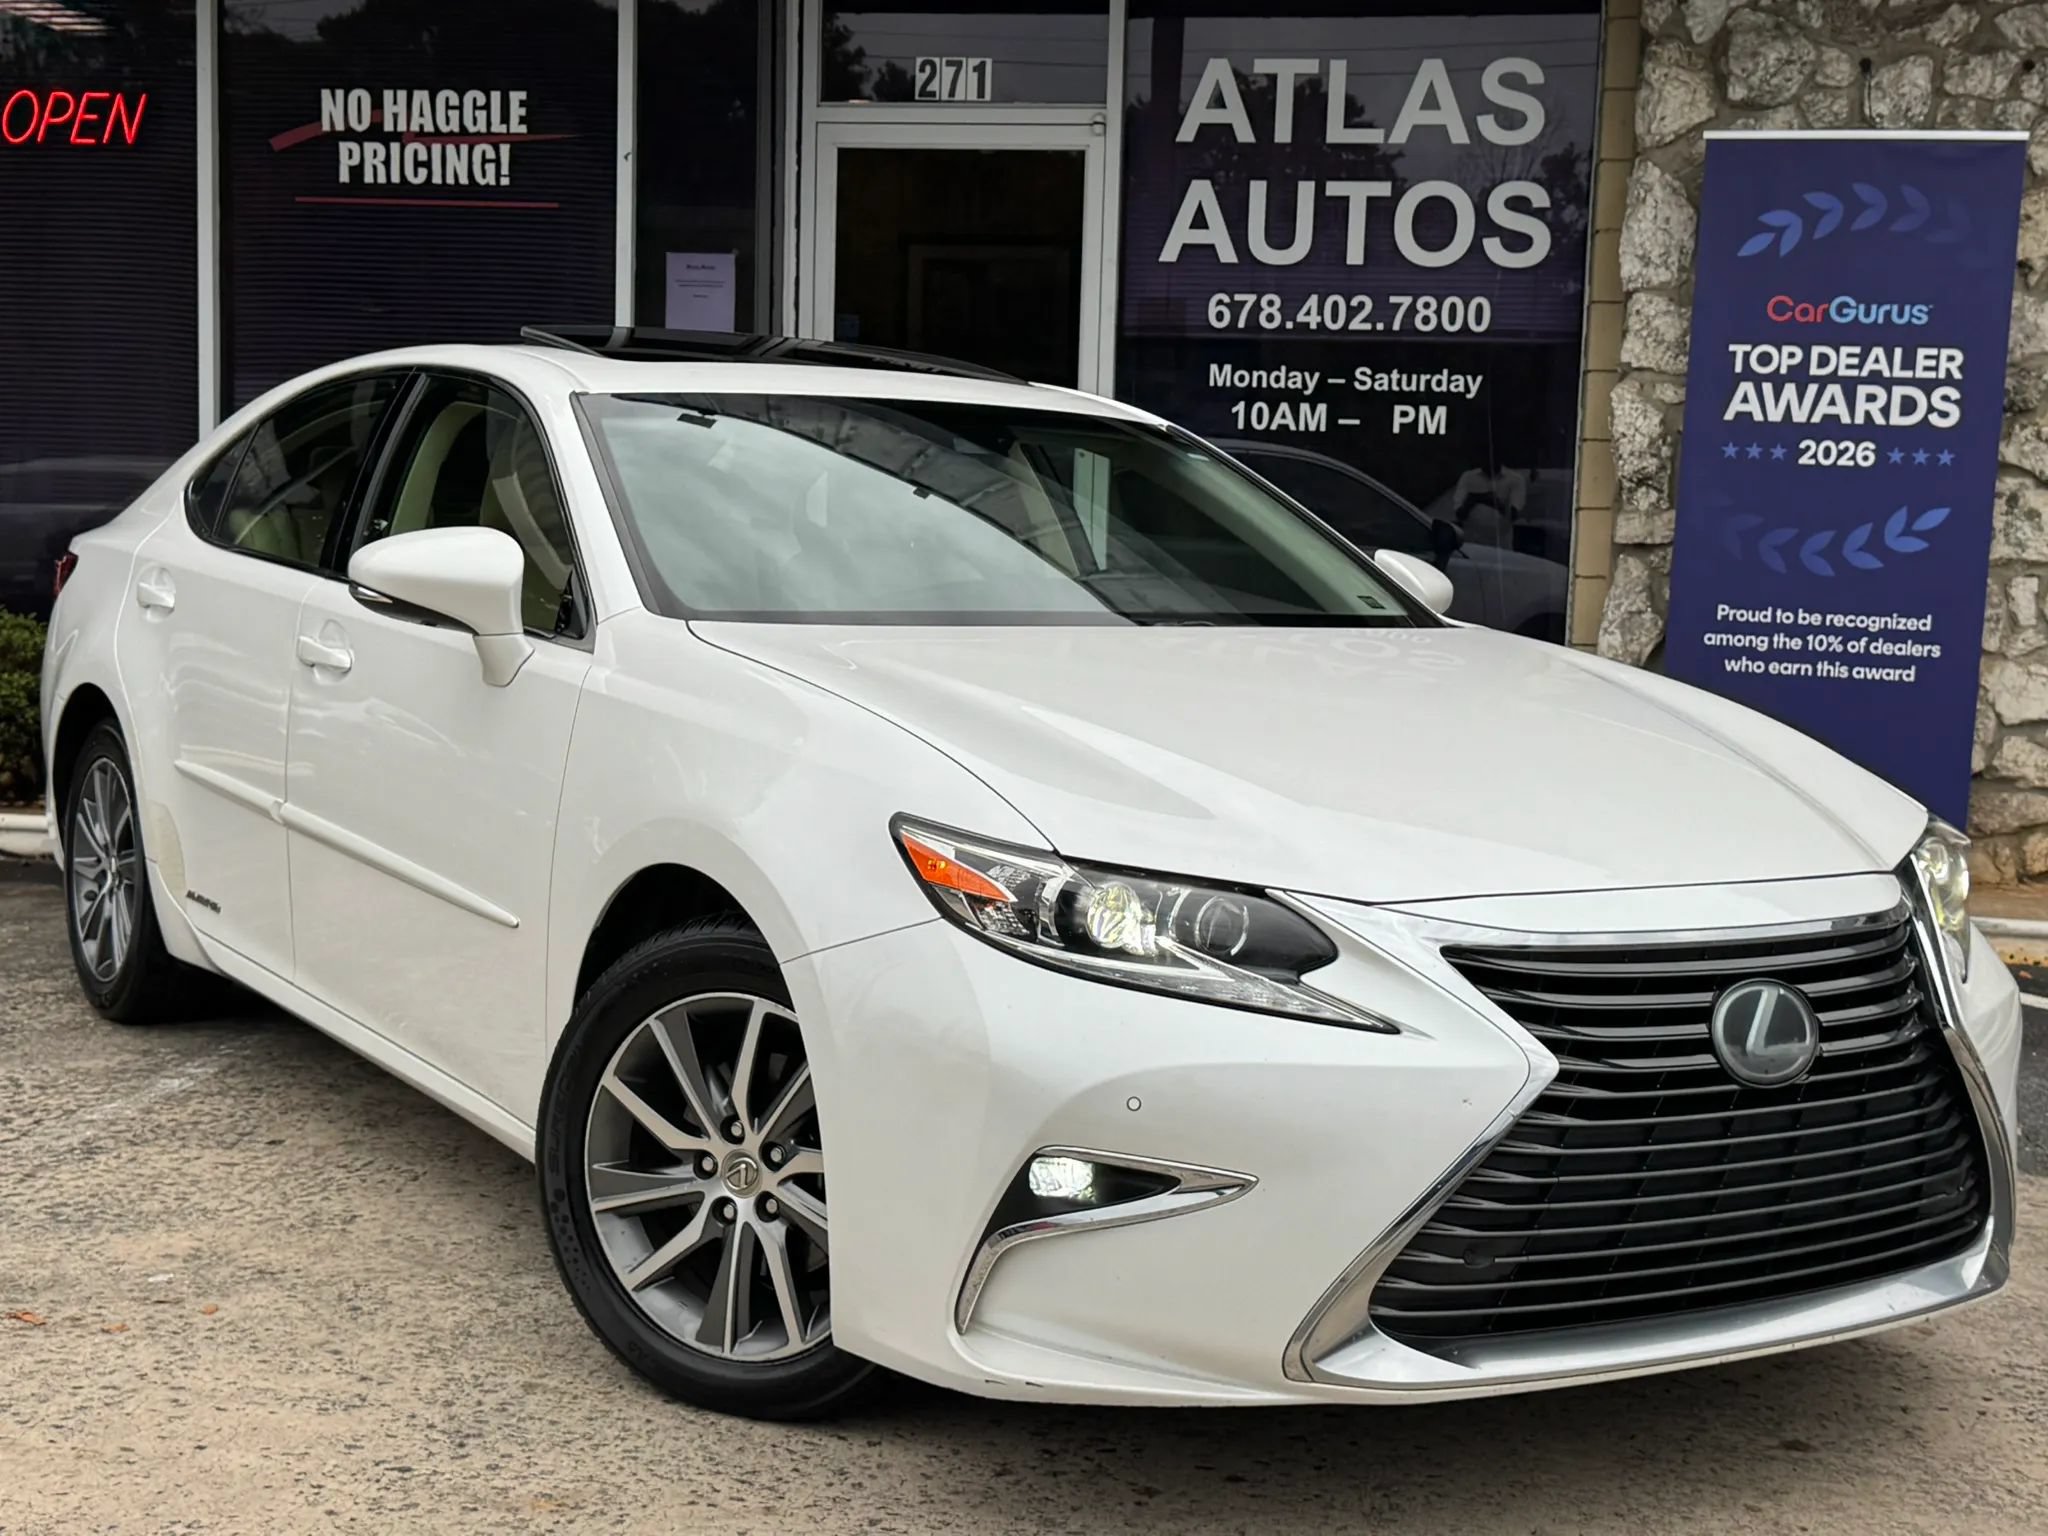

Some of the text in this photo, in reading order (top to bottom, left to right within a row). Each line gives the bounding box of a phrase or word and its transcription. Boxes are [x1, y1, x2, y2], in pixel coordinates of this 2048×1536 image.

[918, 58, 986, 99] 271
[1, 88, 148, 147] OPEN
[320, 88, 528, 134] NO HAGGLE
[1175, 57, 1546, 147] ATLAS
[338, 141, 511, 187] PRICING!
[1157, 178, 1552, 269] AUTOS
[1207, 292, 1492, 334] 678.402.7800
[1766, 295, 1934, 325] CarGurus
[1208, 363, 1320, 395] Monday
[1353, 366, 1483, 399] Saturday
[1728, 343, 1965, 381] TOP DEALER
[1230, 401, 1328, 432] 10AM
[1392, 404, 1448, 435] PM
[1722, 381, 1962, 429] AWARDS
[1798, 439, 1877, 468] 2026
[1716, 604, 1932, 632] Proud to be recognized
[1703, 632, 1942, 658] among the 10% of dealers
[1724, 655, 1917, 683] who earn this award
